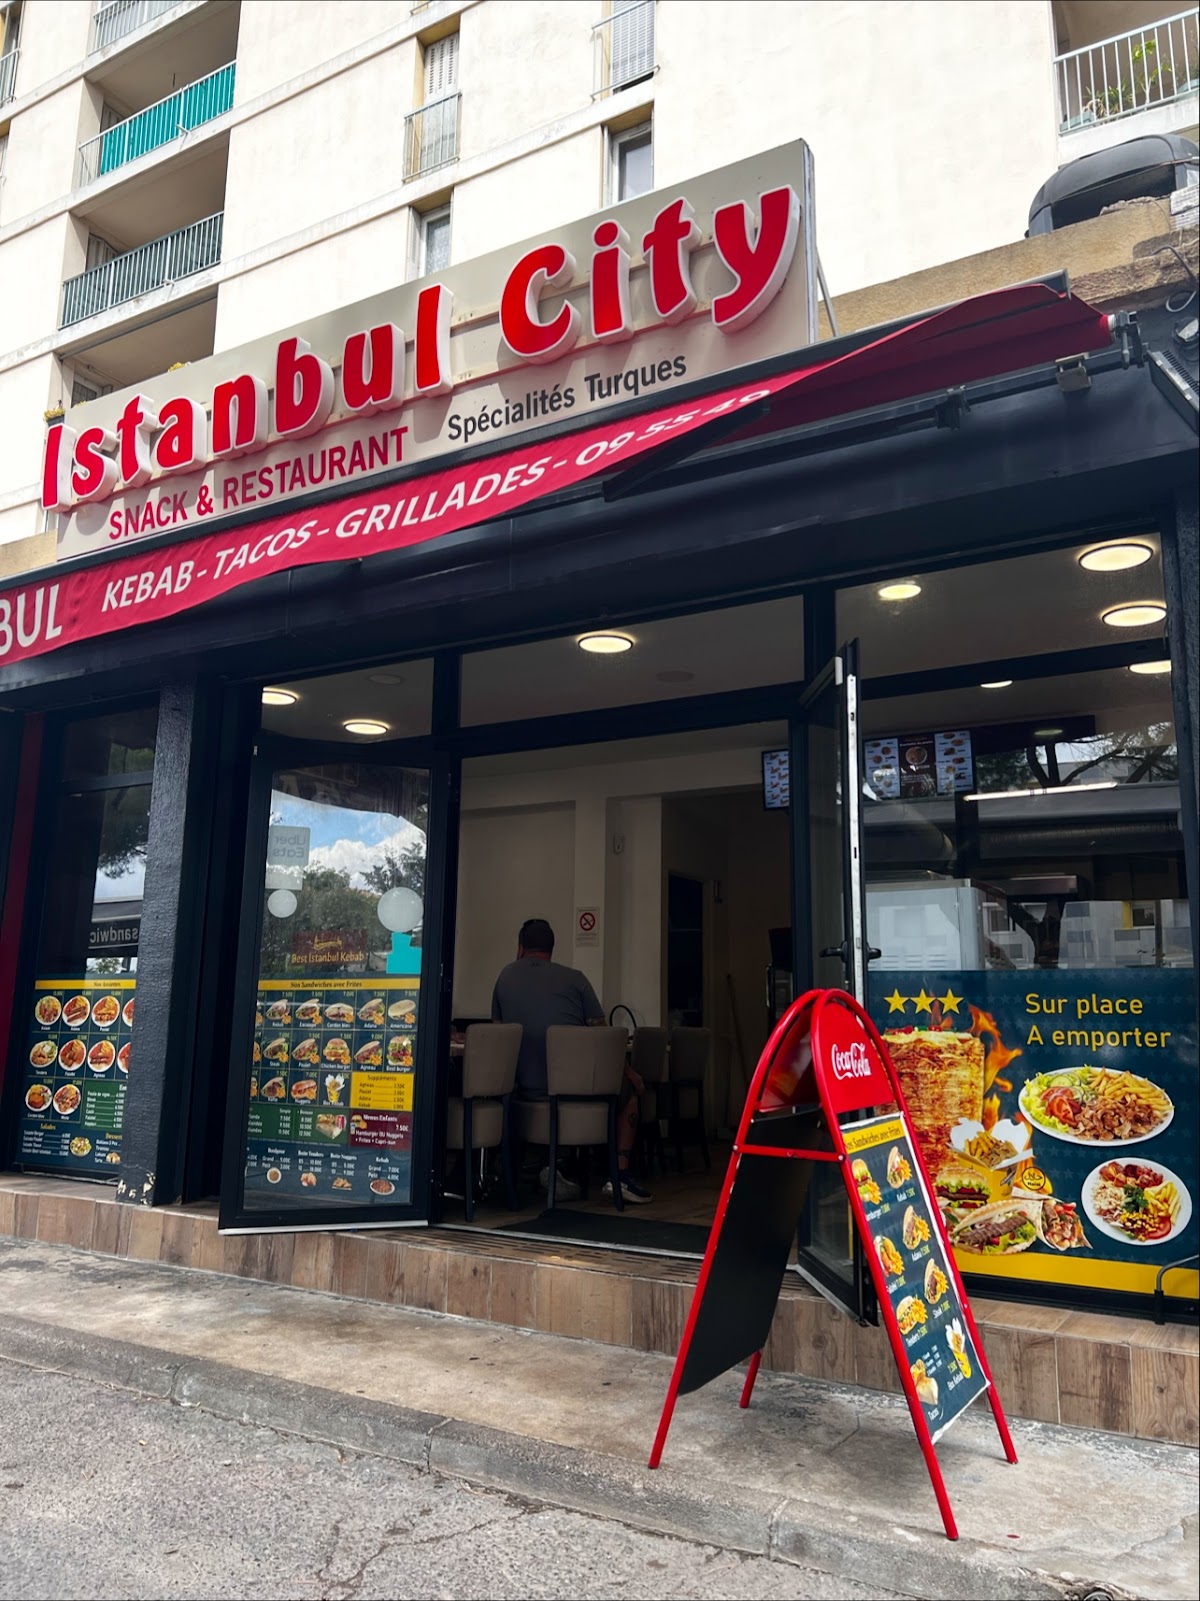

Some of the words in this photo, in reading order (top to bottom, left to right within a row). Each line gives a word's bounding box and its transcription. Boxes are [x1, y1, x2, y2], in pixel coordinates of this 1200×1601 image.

[41, 283, 452, 512] Istanbul
[500, 185, 796, 361] City
[448, 385, 575, 443] Spécialités
[585, 354, 687, 398] Turques
[109, 490, 187, 540] SNACK
[197, 485, 213, 516] &
[223, 426, 409, 509] RESTAURANT
[291, 952, 307, 963] Best
[308, 951, 339, 963] Istanbul
[340, 951, 364, 962] Kebab
[1025, 993, 1067, 1015] Sur
[1076, 993, 1143, 1018] place
[1026, 1025, 1044, 1046] A
[1051, 1027, 1172, 1052] emporter
